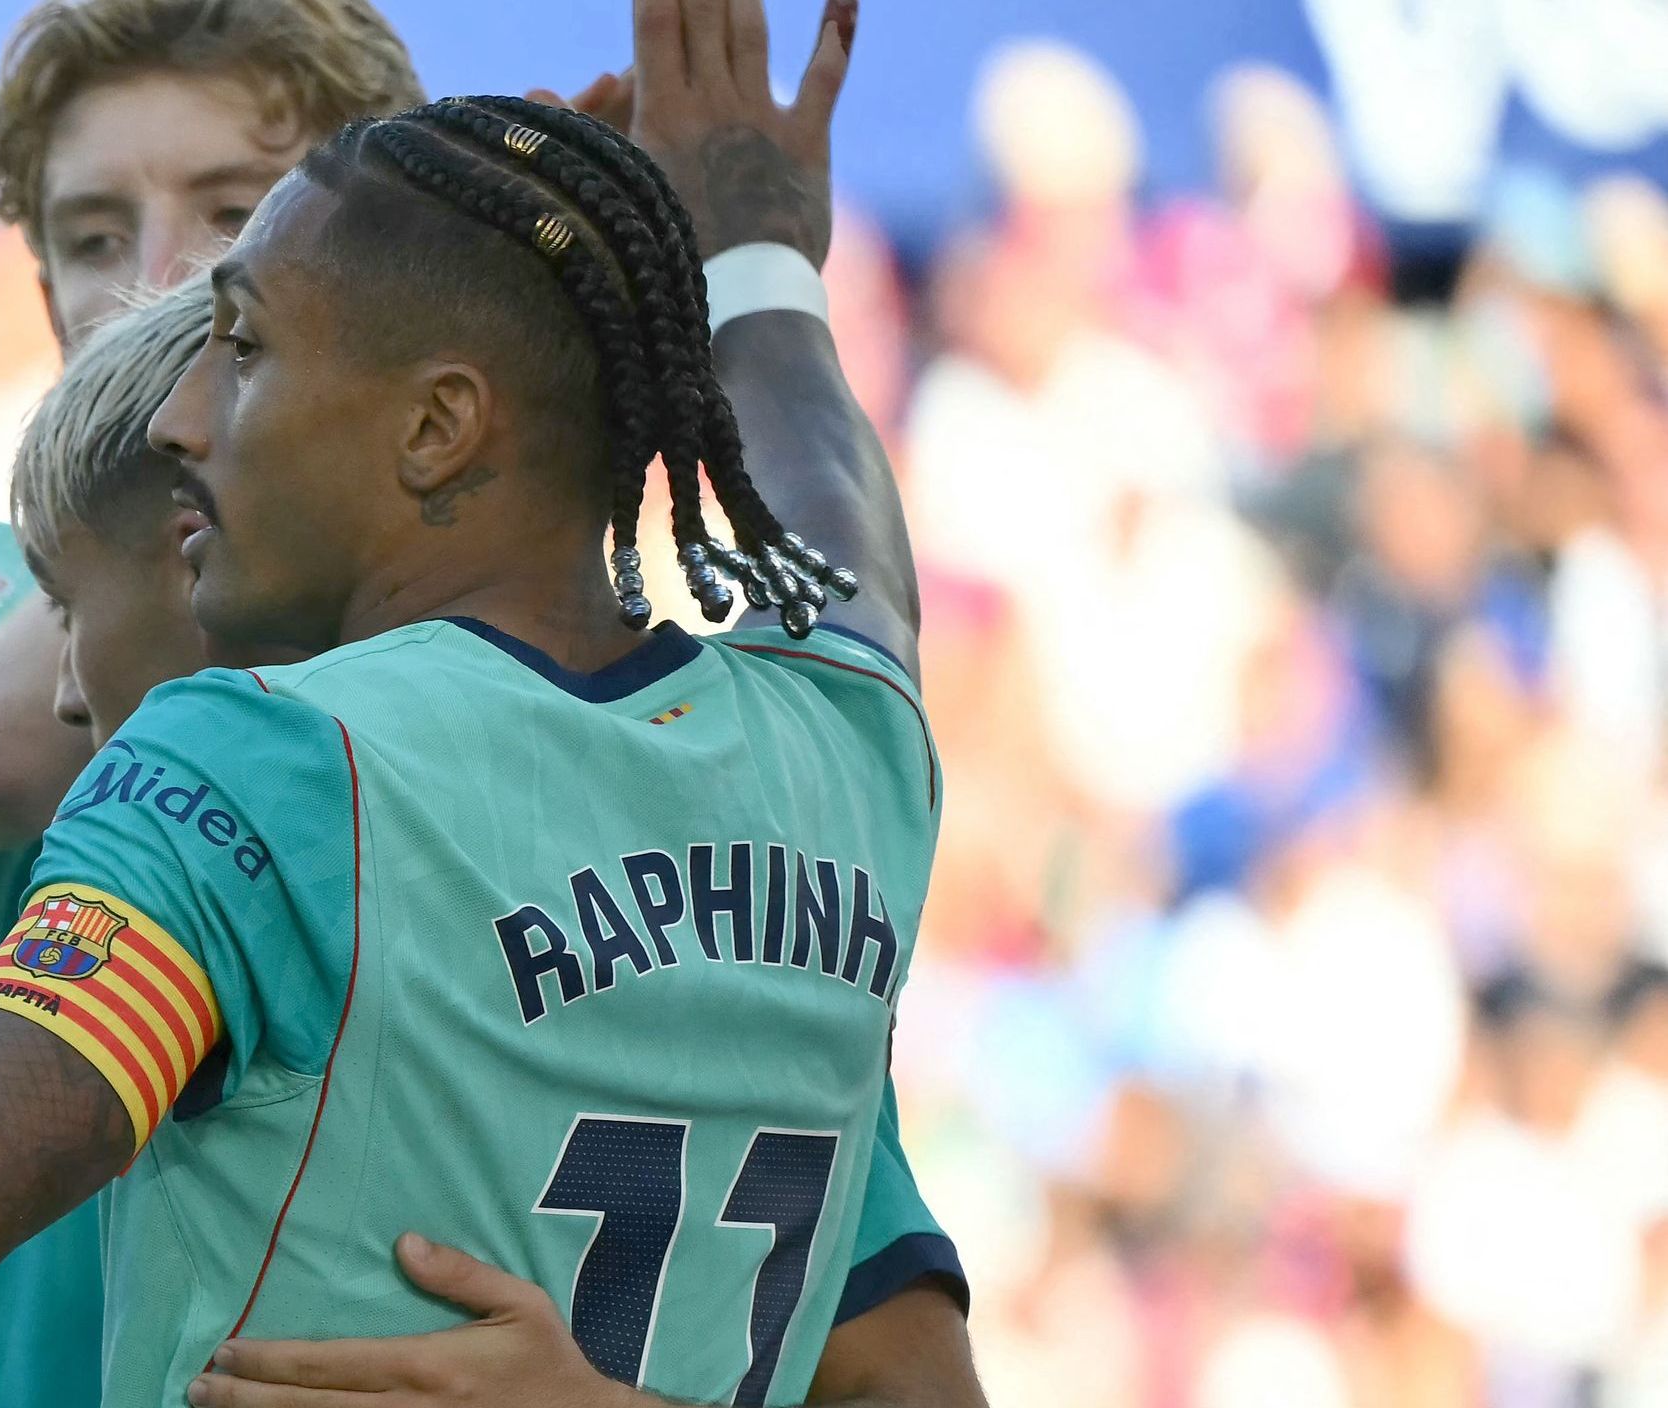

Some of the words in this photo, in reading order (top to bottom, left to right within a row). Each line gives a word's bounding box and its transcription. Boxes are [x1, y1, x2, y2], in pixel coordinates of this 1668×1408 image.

[54, 739, 273, 882] Midea
[45, 929, 82, 947] FCB
[491, 840, 900, 1027] RAPHINH
